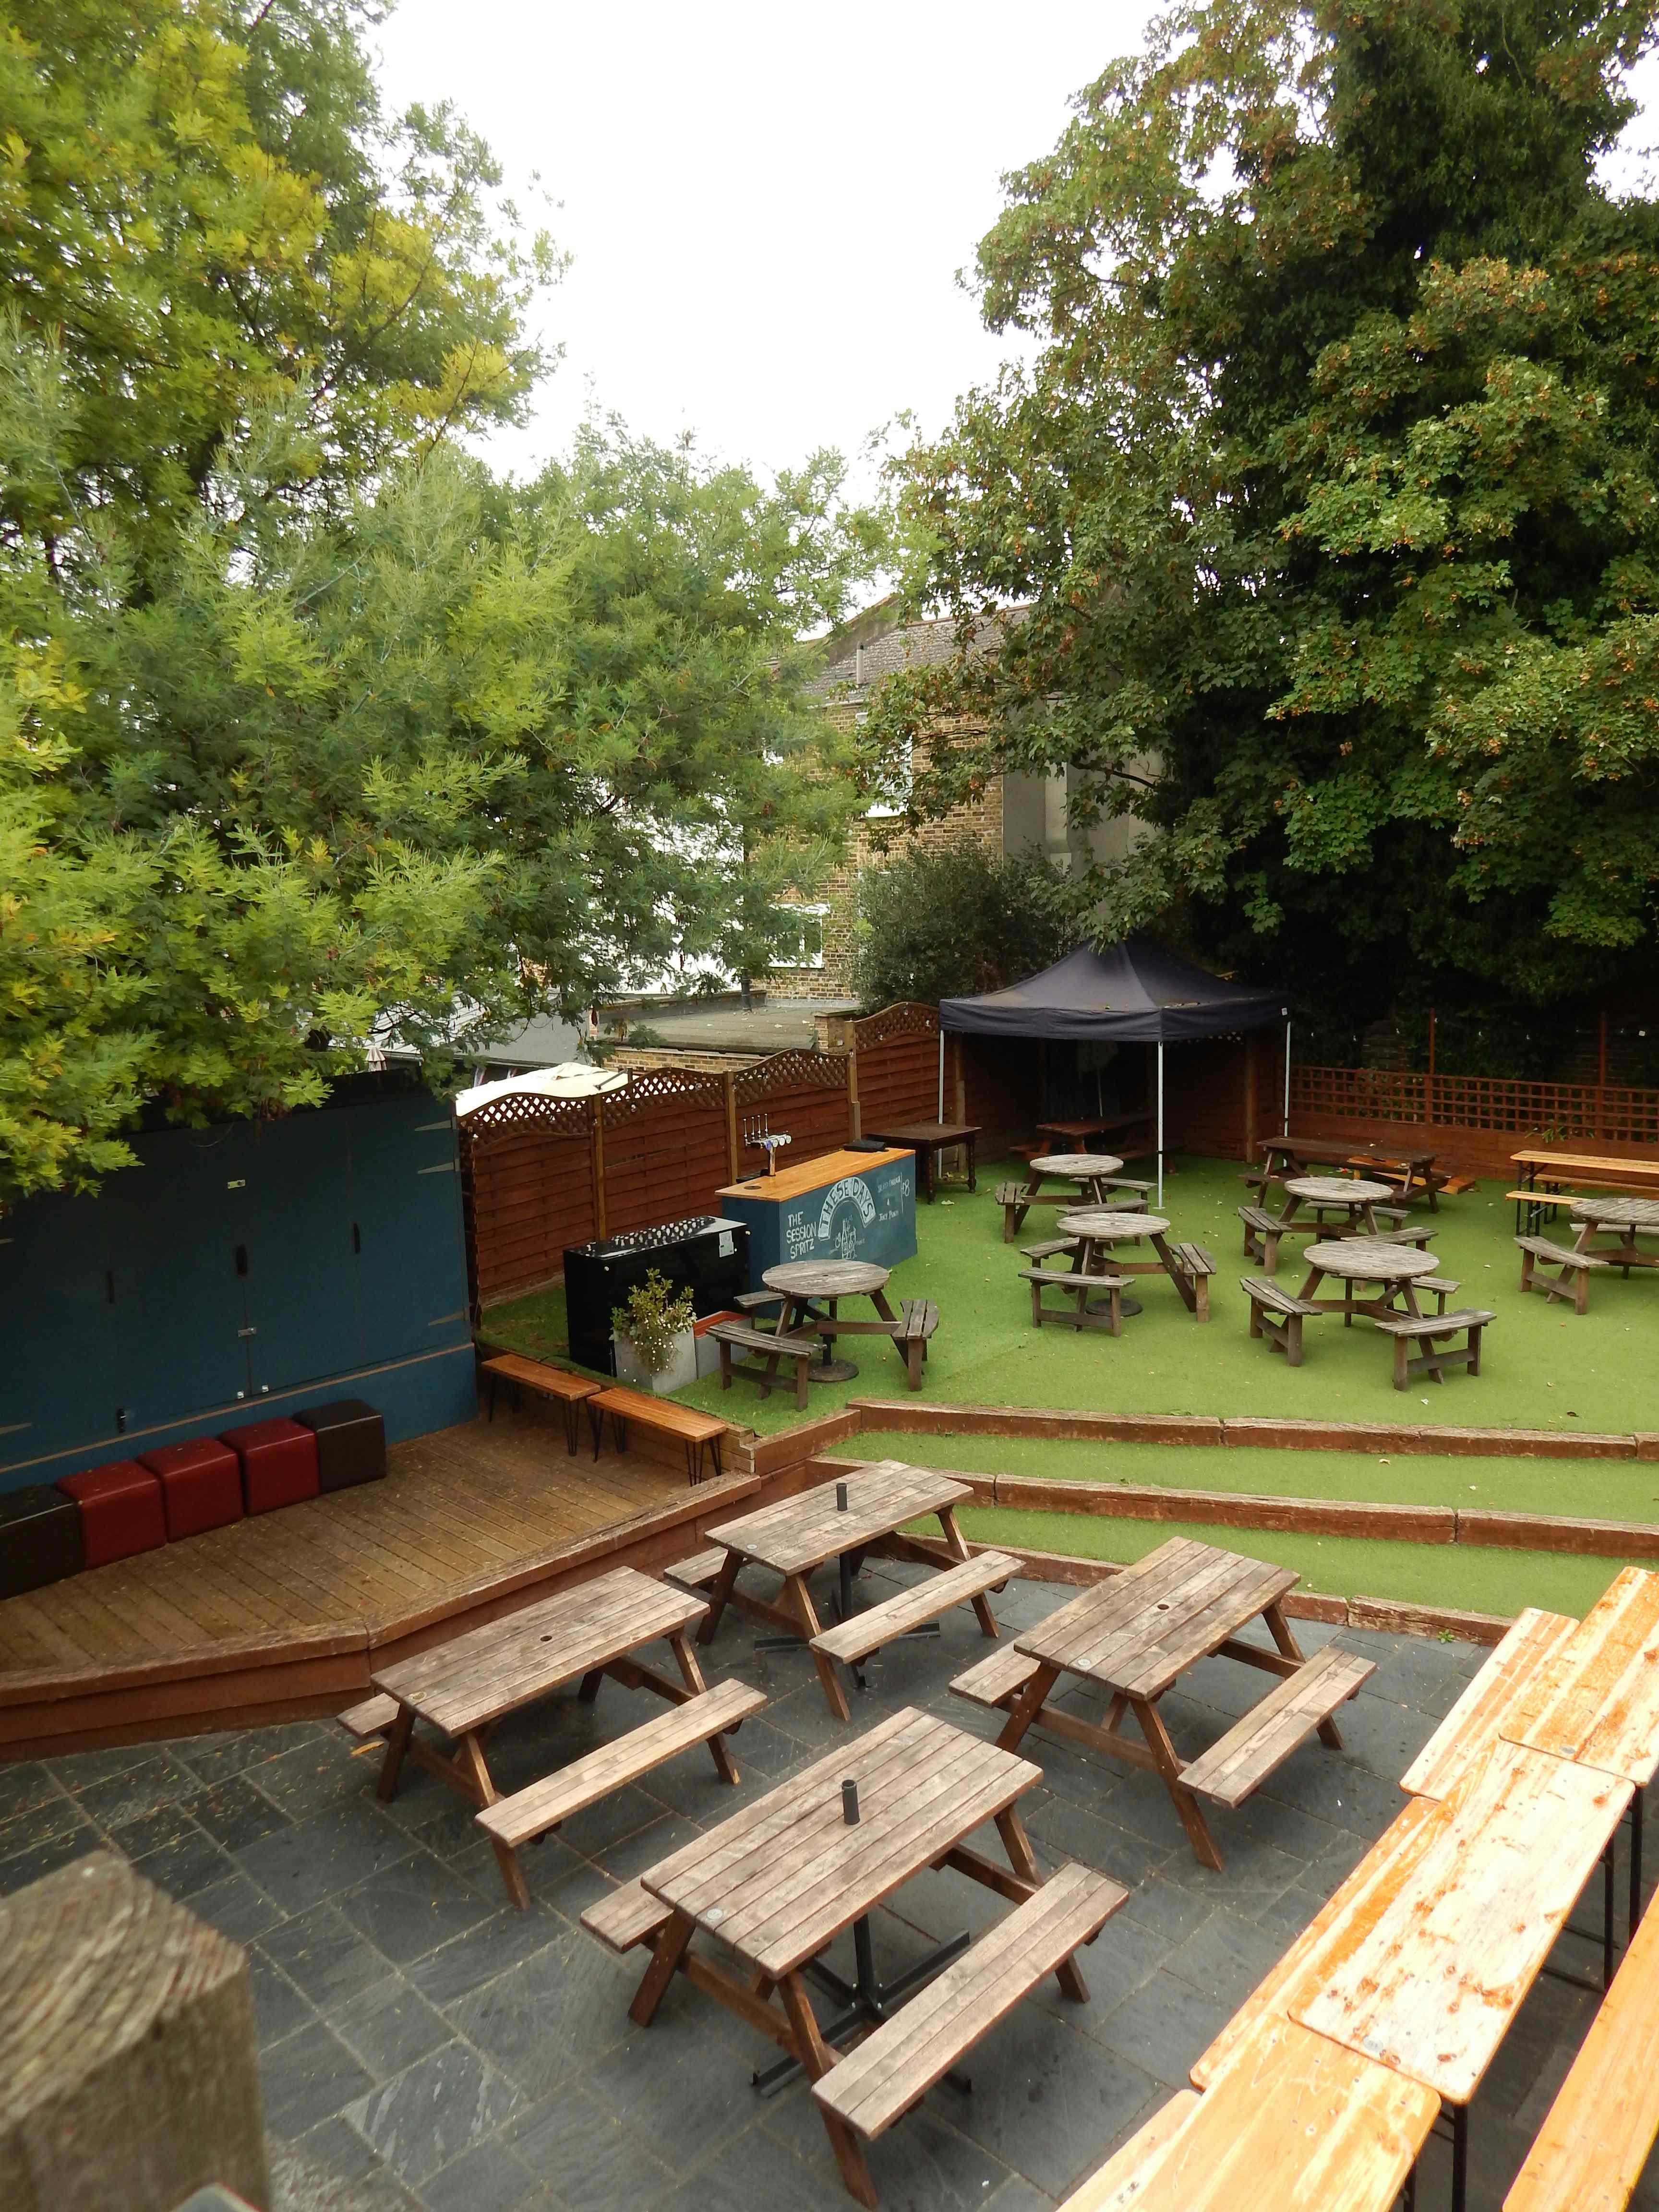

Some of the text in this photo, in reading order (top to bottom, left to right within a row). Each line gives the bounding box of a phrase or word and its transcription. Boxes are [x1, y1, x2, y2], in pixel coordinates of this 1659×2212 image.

[820, 1178, 874, 1229] THESE DAYS
[788, 1211, 804, 1227] THE
[786, 1221, 817, 1244] SESSION
[790, 1238, 815, 1260] SPRITZ
